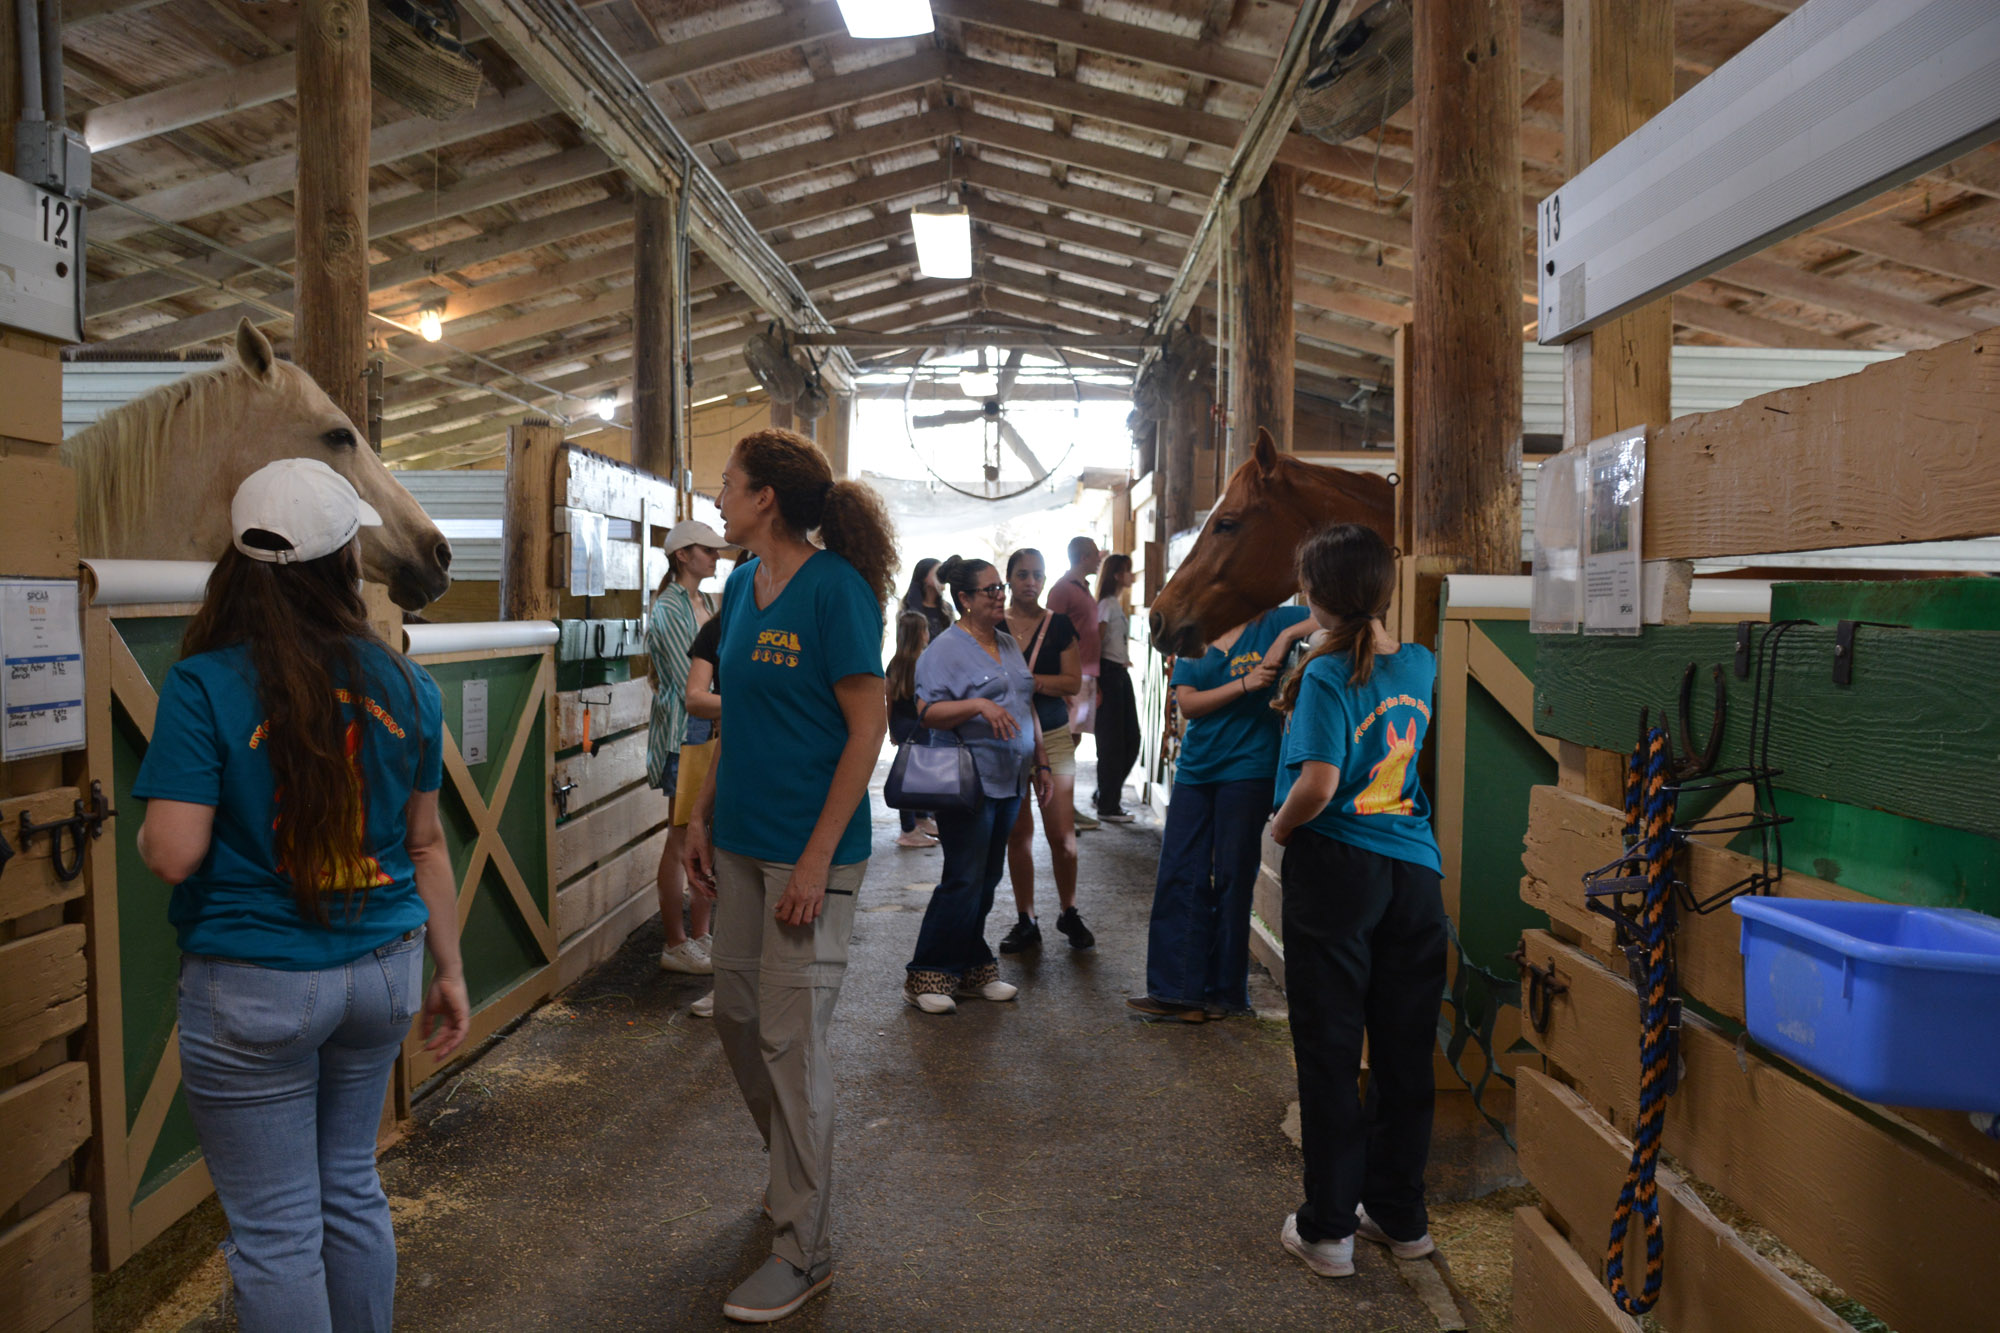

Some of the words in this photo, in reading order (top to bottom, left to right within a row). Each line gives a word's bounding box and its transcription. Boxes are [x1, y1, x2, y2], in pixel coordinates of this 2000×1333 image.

[41, 195, 69, 249] 12
[1546, 195, 1560, 247] 13
[757, 631, 788, 647] SPCA
